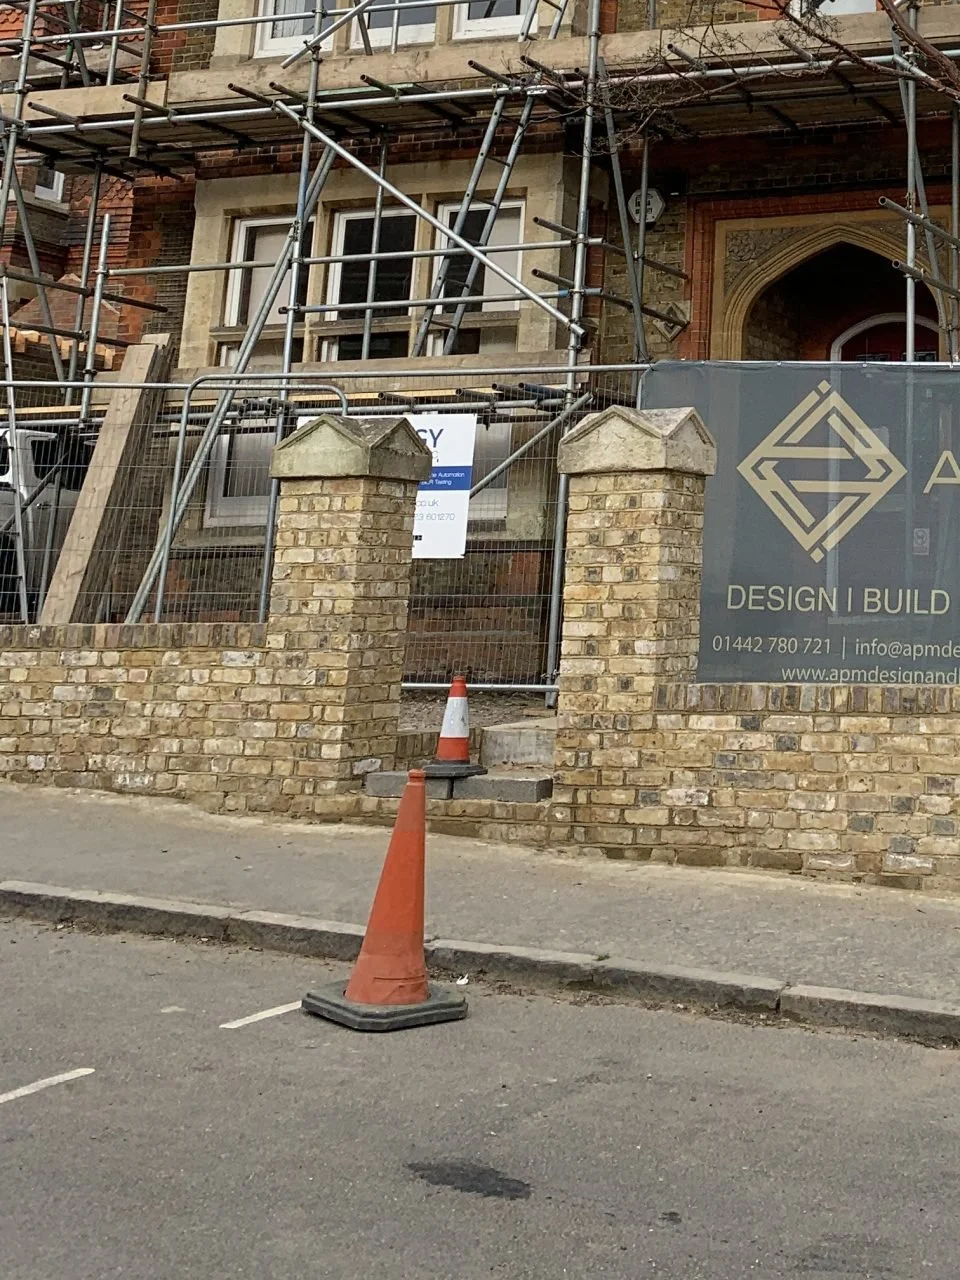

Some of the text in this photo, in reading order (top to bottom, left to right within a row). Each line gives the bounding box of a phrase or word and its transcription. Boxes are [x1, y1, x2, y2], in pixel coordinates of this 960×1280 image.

[727, 584, 837, 612] DESIGN
[863, 588, 950, 615] BUILD
[712, 635, 762, 653] 01442
[768, 637, 798, 654] 780
[803, 638, 831, 654] 721
